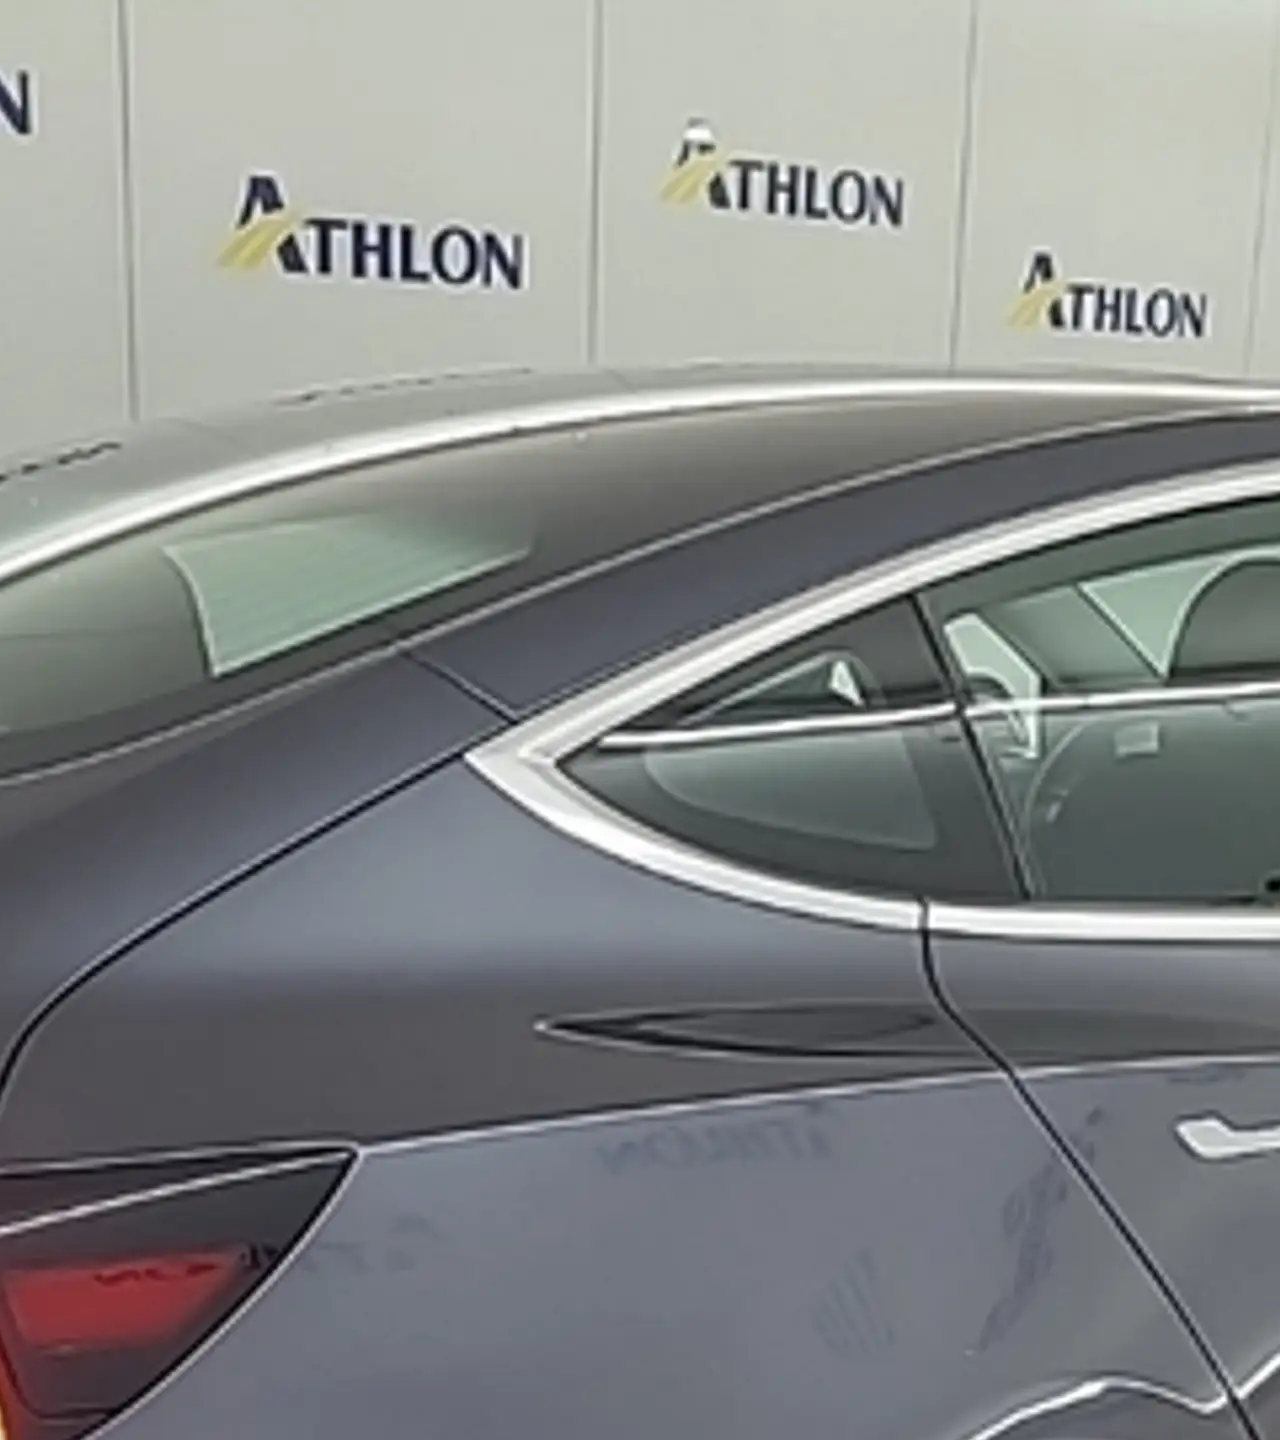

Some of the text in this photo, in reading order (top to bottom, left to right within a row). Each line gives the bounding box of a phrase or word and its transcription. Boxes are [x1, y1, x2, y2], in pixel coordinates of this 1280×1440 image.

[659, 117, 905, 228] ATHLON
[216, 173, 526, 289] ATHLON
[1006, 250, 1208, 339] ATHLON
